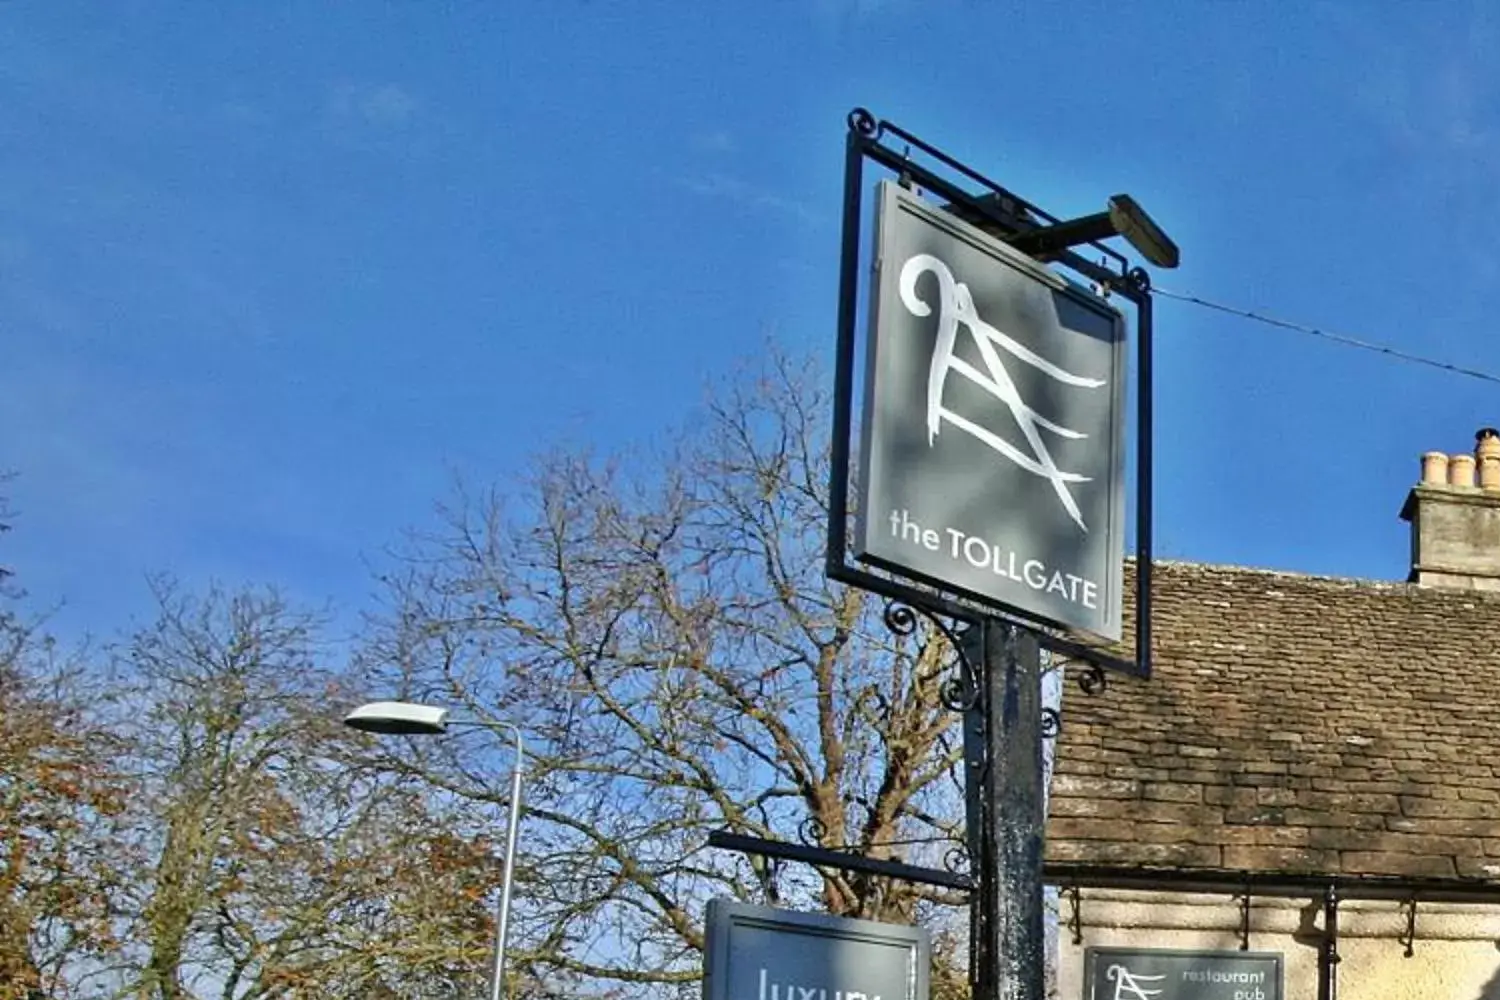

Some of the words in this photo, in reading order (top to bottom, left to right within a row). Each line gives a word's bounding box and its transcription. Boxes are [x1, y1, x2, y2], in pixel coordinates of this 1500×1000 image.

[889, 509, 940, 550] the
[946, 527, 1098, 609] TOLLGATE
[1182, 967, 1264, 983] restaurant
